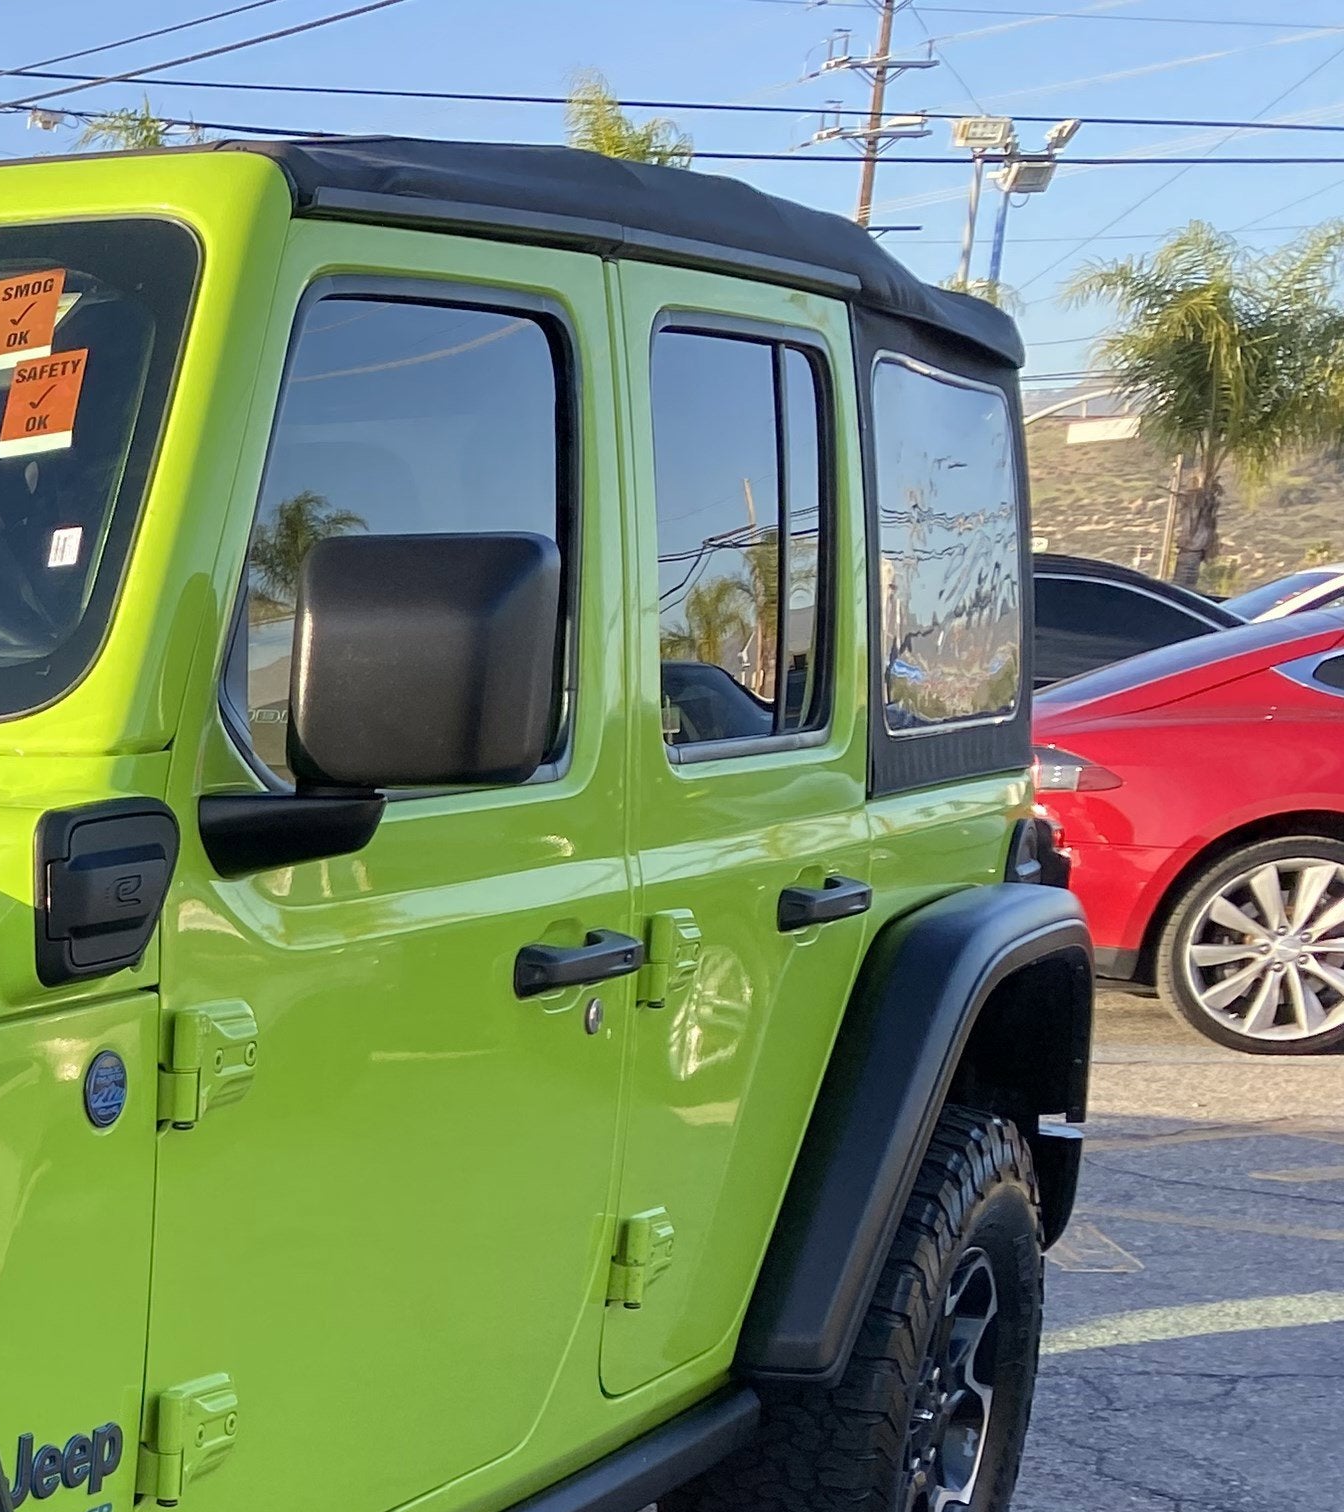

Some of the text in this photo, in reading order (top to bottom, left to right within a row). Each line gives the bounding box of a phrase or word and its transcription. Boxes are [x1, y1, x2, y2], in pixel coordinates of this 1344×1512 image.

[2, 278, 54, 301] SMOG
[7, 330, 30, 347] OK
[16, 359, 82, 383] SAFETY
[25, 414, 50, 432] OK
[11, 1421, 123, 1510] Jeep
